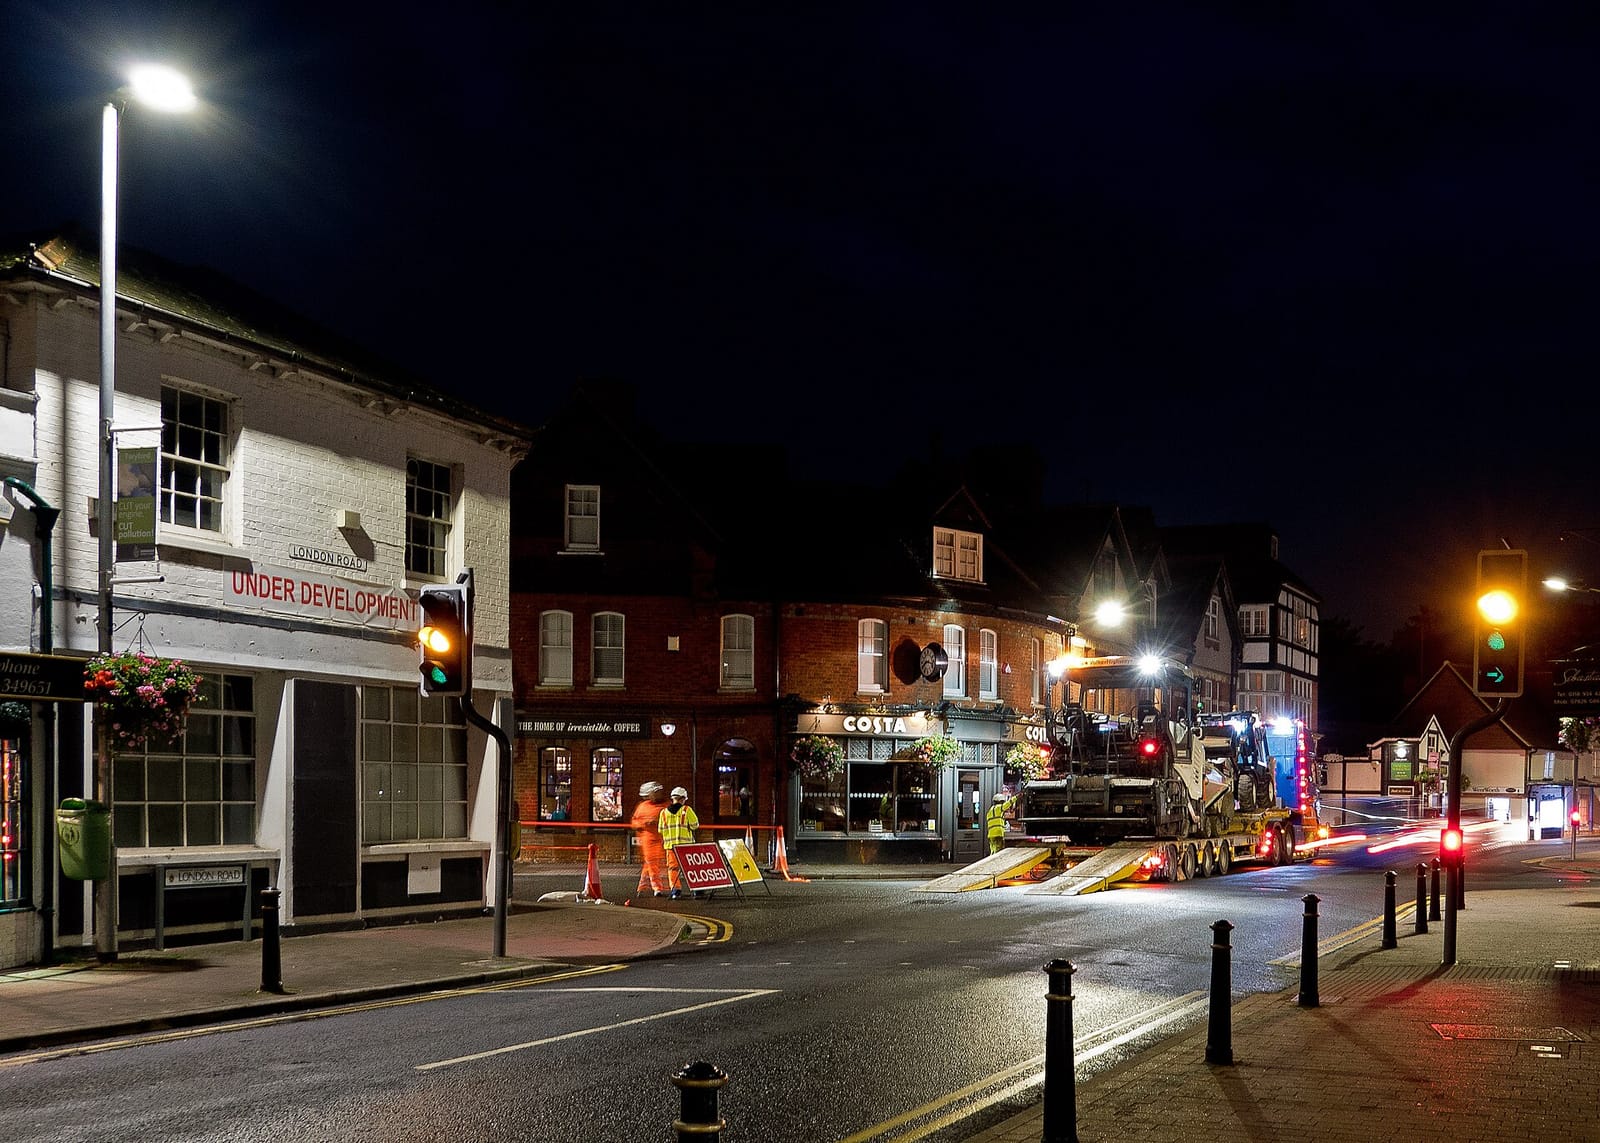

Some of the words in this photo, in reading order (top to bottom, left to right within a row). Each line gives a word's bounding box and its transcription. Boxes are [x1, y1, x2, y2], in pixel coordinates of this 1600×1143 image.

[118, 502, 133, 511] CUT
[134, 503, 152, 512] your
[118, 522, 133, 530] CUT
[118, 528, 154, 541] pollution!
[293, 545, 334, 563] LONDON
[336, 554, 363, 569] ROAD
[232, 571, 296, 603] UNDER
[301, 581, 419, 622] DEVELOPMENT
[1, 677, 52, 695] 349651
[518, 721, 533, 731] THE
[534, 721, 555, 731] HOME
[555, 721, 566, 731] OF
[567, 722, 612, 732] irresistible
[613, 723, 641, 733] COFFEE
[843, 715, 907, 735] COSTA
[685, 852, 715, 866] ROAD
[178, 870, 214, 882] LONDON
[217, 869, 241, 880] ROAD
[687, 868, 728, 883] CLOSED
